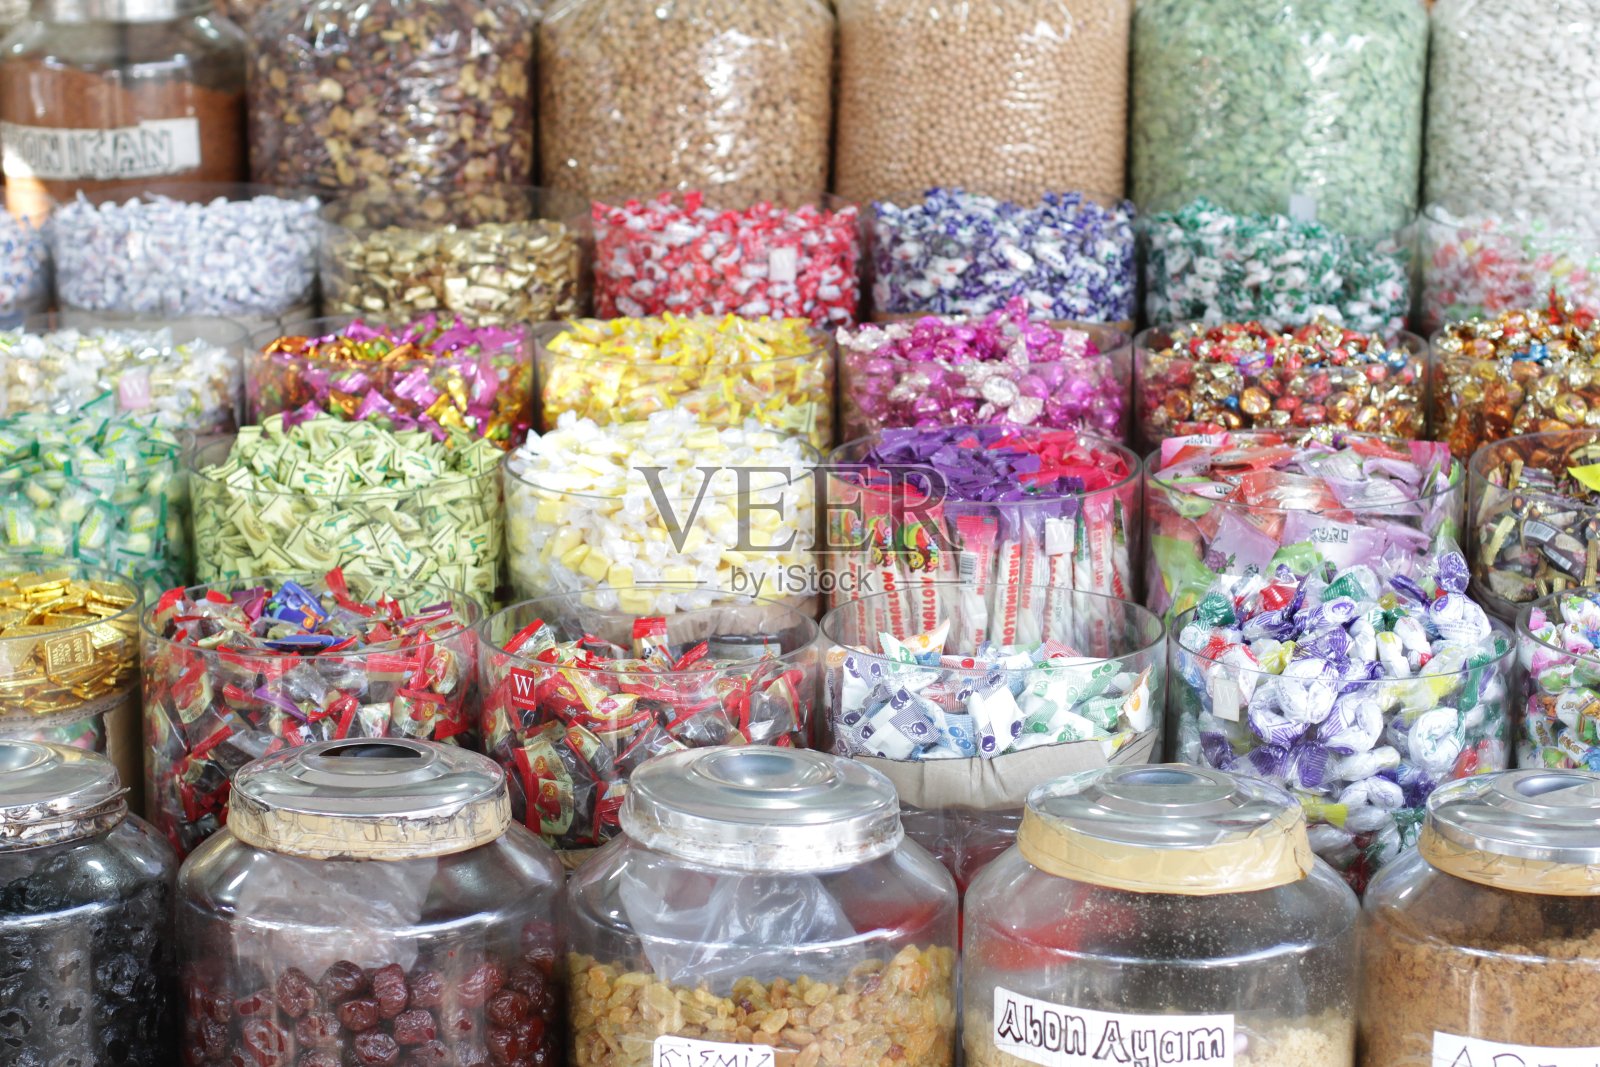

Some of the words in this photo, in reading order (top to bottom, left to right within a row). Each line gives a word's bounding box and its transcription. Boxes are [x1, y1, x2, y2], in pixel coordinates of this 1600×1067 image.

[921, 577, 937, 632] MALLOW
[1002, 543, 1021, 645] MARSHMALLOW
[513, 673, 533, 697] W
[1092, 1020, 1225, 1067] Ayam
